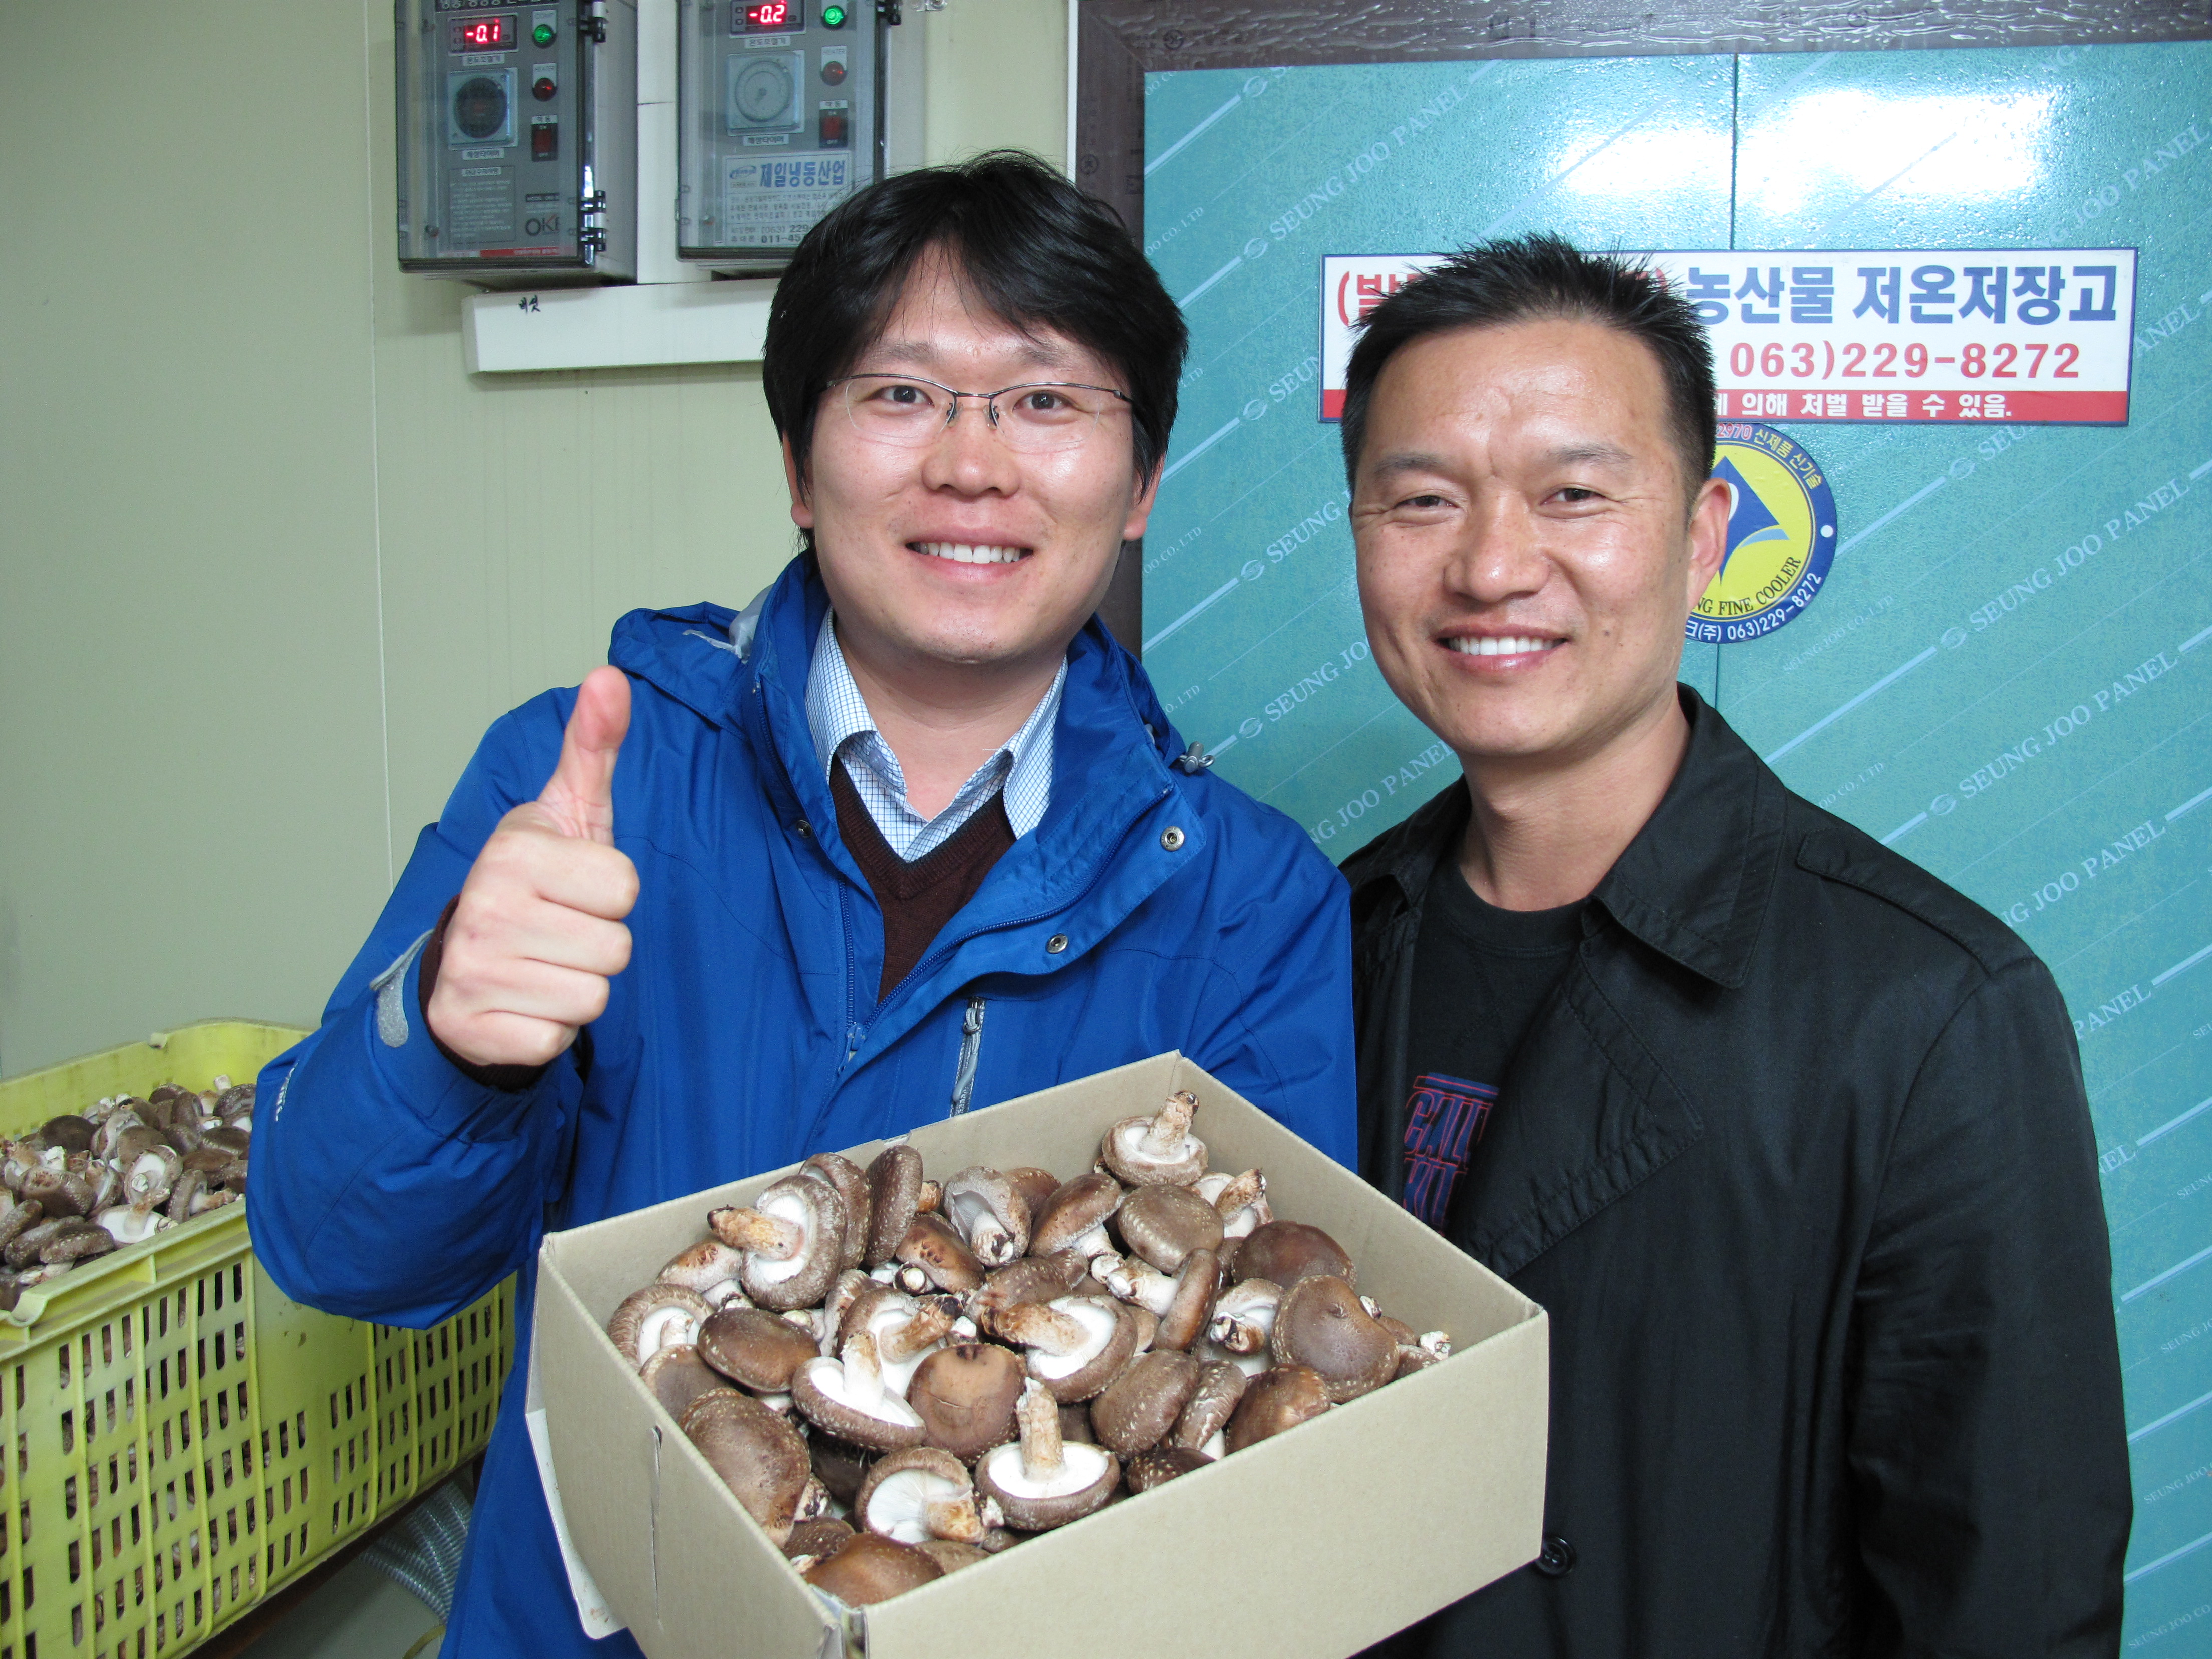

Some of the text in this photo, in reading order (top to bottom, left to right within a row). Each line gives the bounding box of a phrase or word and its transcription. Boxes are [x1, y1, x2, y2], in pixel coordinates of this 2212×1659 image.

[760, 160, 845, 188] 제일냉동산업
[1269, 83, 1469, 241] SEUNG JOO PANEL
[2122, 124, 2210, 192] PANEL
[761, 234, 805, 244] 011-45
[1686, 267, 1834, 325] 농산물
[1853, 265, 2117, 325] 저온저장고
[2135, 303, 2202, 358] ANEL
[1269, 355, 1319, 403] SEUN
[1730, 340, 2080, 379] 063)229-8272
[1741, 393, 1788, 416] 의해
[1800, 393, 1847, 417] 처벌
[1862, 393, 1908, 417] 받을
[1922, 394, 1945, 417] 수
[1959, 394, 2012, 418] 있음.
[1754, 429, 1794, 458] 신제품
[1789, 453, 1822, 489] 신기술
[1266, 500, 1342, 564] SEUNG
[1969, 478, 2190, 632] SEUNG JOO PANEL
[1685, 573, 1822, 642] 크(주) 063)229-8272
[1697, 557, 1801, 615] NG FINE COOLER
[1264, 636, 1371, 723] SEUNG JO
[1959, 651, 2178, 799] SEUNG JOO PANEL
[1336, 789, 1380, 827] JOO
[2031, 818, 2166, 911] JOO PANEL
[2074, 984, 2152, 1040] PANEL
[2160, 1327, 2201, 1353] SEUNG
[2144, 1466, 2208, 1505] SEUNG JOO
[2128, 1624, 2168, 1650] SEUNG
